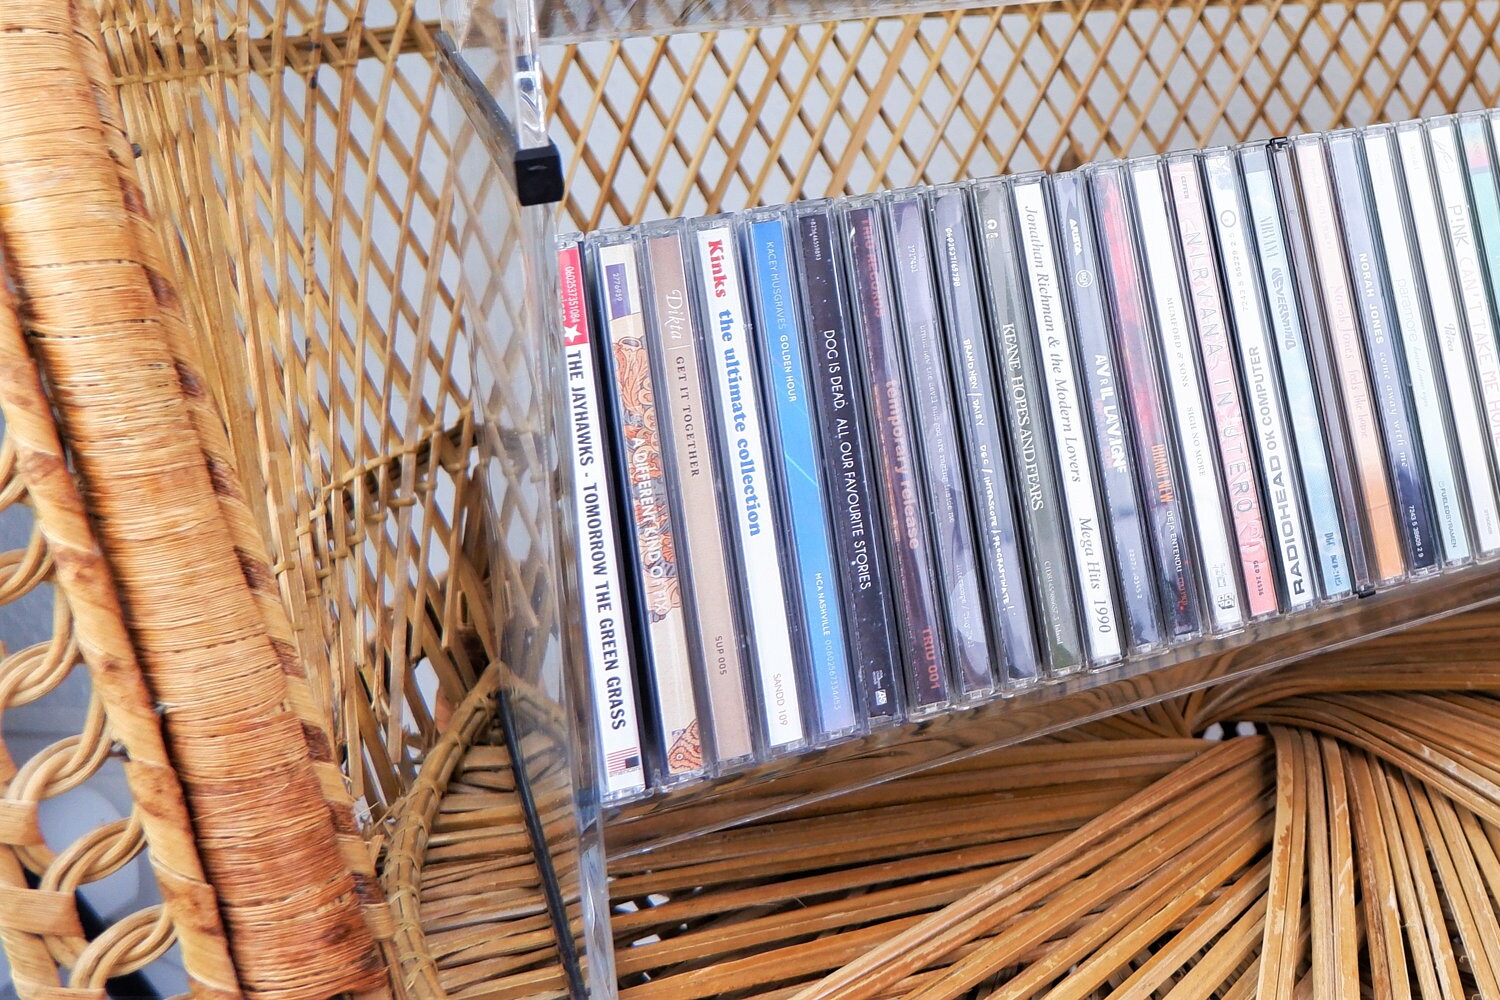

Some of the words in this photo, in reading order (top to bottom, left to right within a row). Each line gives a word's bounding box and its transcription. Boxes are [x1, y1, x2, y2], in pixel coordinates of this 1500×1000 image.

[764, 241, 778, 270] KACEY
[1024, 204, 1045, 267] Jonathan
[707, 238, 730, 298] Kinks
[1259, 216, 1278, 257] NIRVANA
[1271, 267, 1296, 349] NEVERMIND
[1358, 253, 1374, 296] NORAH
[564, 265, 580, 322] 0602537351084
[770, 273, 786, 330] MUSGRAVES
[1035, 272, 1057, 331] Richman
[1448, 205, 1468, 246] P!NK
[1460, 257, 1482, 312] CAN'T
[1471, 320, 1492, 364] TAKE
[1482, 371, 1498, 393] ME
[660, 288, 687, 341] Dikta
[718, 309, 736, 342] the
[1368, 303, 1384, 343] JONES
[779, 334, 792, 372] GOLDEN
[823, 329, 838, 360] DOG
[1002, 322, 1021, 372] KEANE
[1046, 335, 1060, 347] &
[566, 350, 583, 380] THE
[673, 355, 687, 382] GET
[827, 362, 840, 374] IS
[1050, 353, 1064, 373] the
[1378, 351, 1391, 379] come
[678, 386, 690, 400] IT
[722, 347, 750, 432] ultimate
[784, 375, 797, 402] HOUR
[829, 375, 845, 411] DEAD.
[1011, 375, 1029, 425] HOPES
[1054, 378, 1074, 431] Modern
[1249, 345, 1271, 426] COMPUTER
[1384, 385, 1397, 414] away
[571, 385, 593, 466] JAYHAWKS
[835, 417, 849, 439] ALL
[1093, 352, 1113, 401] AVRIL
[1103, 404, 1126, 473] LAVIGNE
[1392, 420, 1405, 445] with
[680, 404, 700, 477] TOGETHER
[839, 441, 853, 469] OUR
[1020, 428, 1036, 464] AND
[1064, 436, 1084, 481] Lovers
[1263, 430, 1276, 451] OK
[735, 437, 764, 536] collection
[843, 471, 863, 537] FAVOURITE
[1025, 462, 1043, 511] FEARS
[583, 483, 607, 576] TOMORROW
[1076, 516, 1096, 556] Mega
[1269, 454, 1303, 595] RADIOHEAD
[853, 539, 871, 589] STORIES
[1086, 560, 1102, 589] Hits
[595, 581, 612, 612] THE
[1093, 598, 1111, 632] 1990
[600, 617, 618, 670] GREEN
[713, 634, 726, 655] SUP
[716, 656, 729, 676] 005
[606, 675, 626, 730] GRASS
